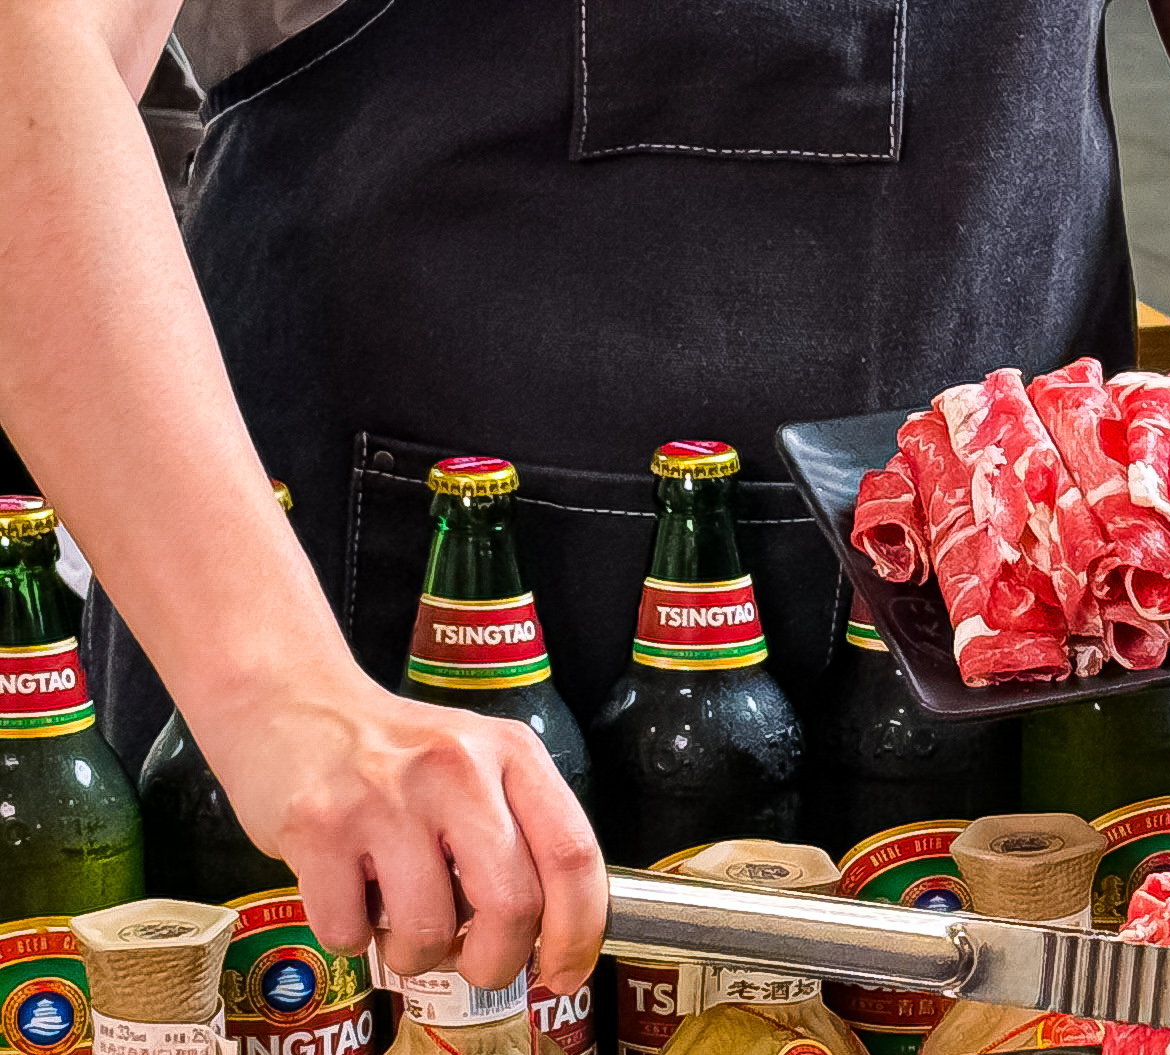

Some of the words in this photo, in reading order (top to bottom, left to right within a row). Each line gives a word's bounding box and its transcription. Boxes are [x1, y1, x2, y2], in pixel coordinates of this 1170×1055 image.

[656, 601, 755, 628] TSINGTAO
[432, 620, 536, 645] TSINGTAO
[0, 667, 76, 694] NGTAO
[1107, 823, 1132, 842] IERE
